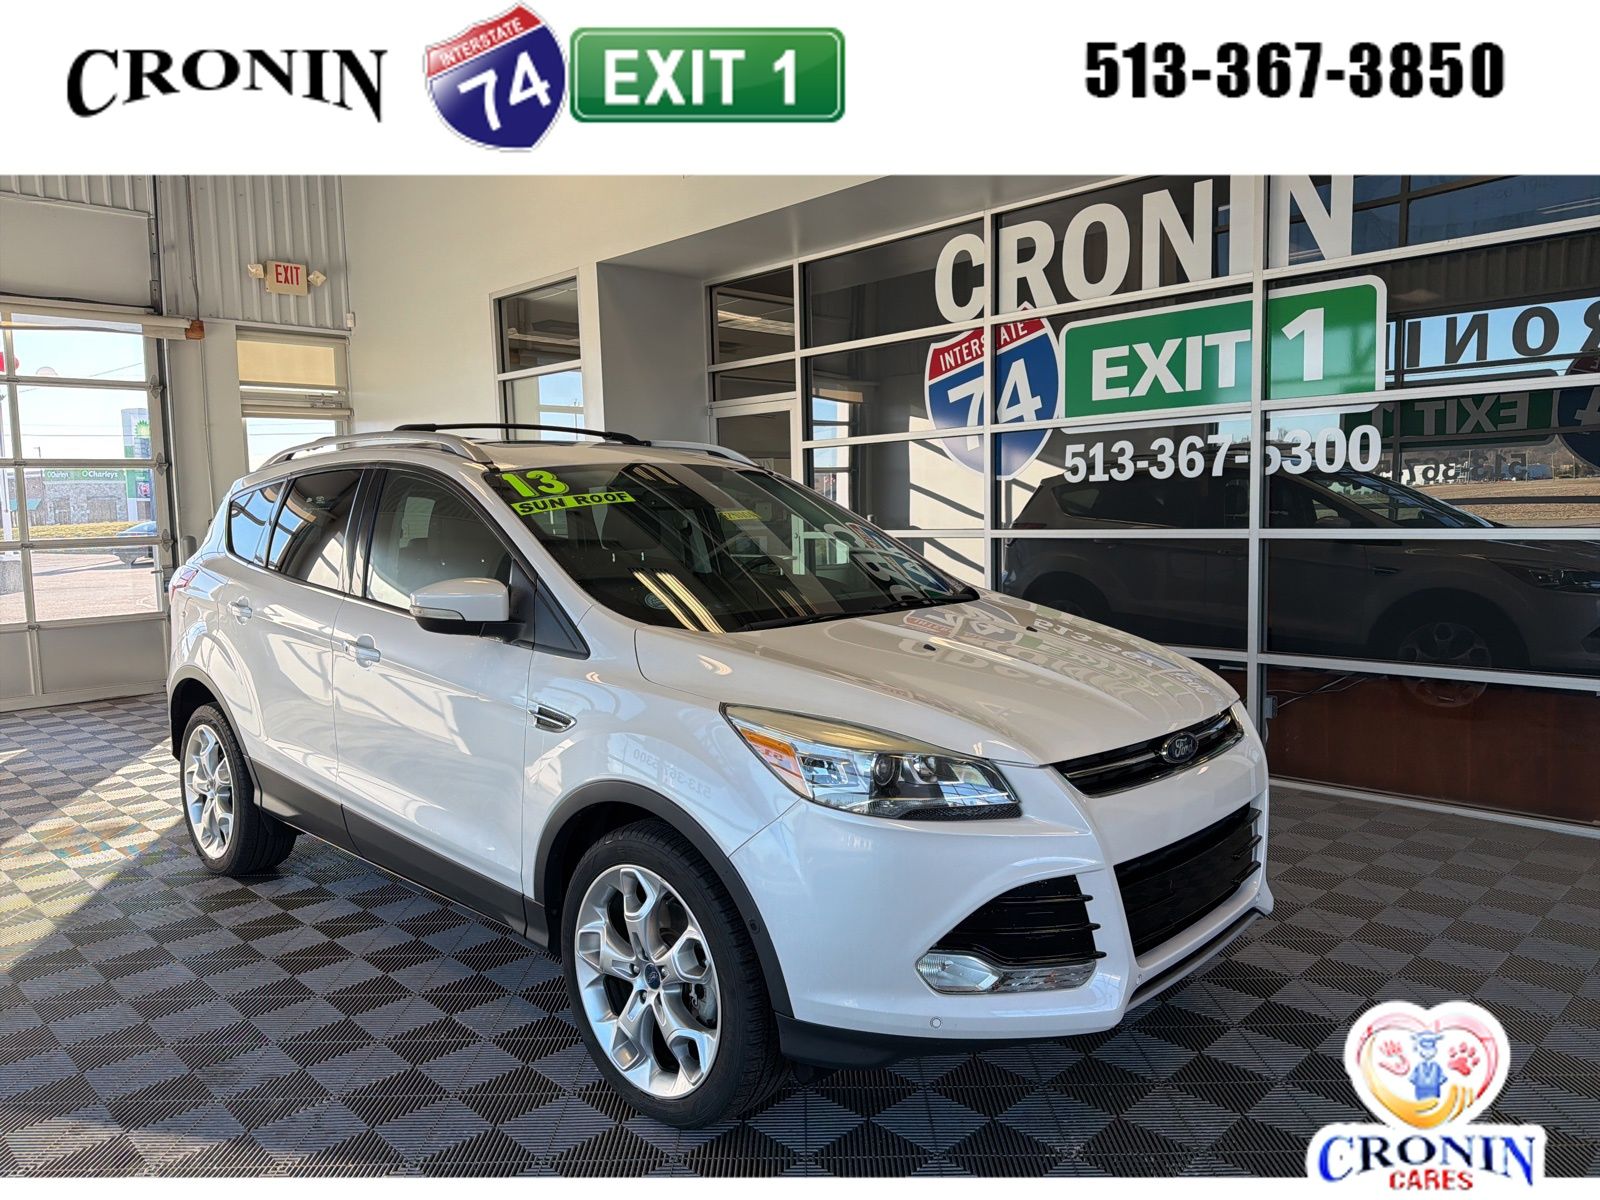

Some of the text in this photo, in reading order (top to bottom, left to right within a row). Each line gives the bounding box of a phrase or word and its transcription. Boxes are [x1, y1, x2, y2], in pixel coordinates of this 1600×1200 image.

[275, 264, 300, 286] EXIT
[935, 175, 1352, 322] CRONIN
[1092, 307, 1324, 401] EXIT 1
[948, 358, 1042, 451] 74
[502, 470, 569, 497] 13
[518, 492, 629, 513] SUN ROOF
